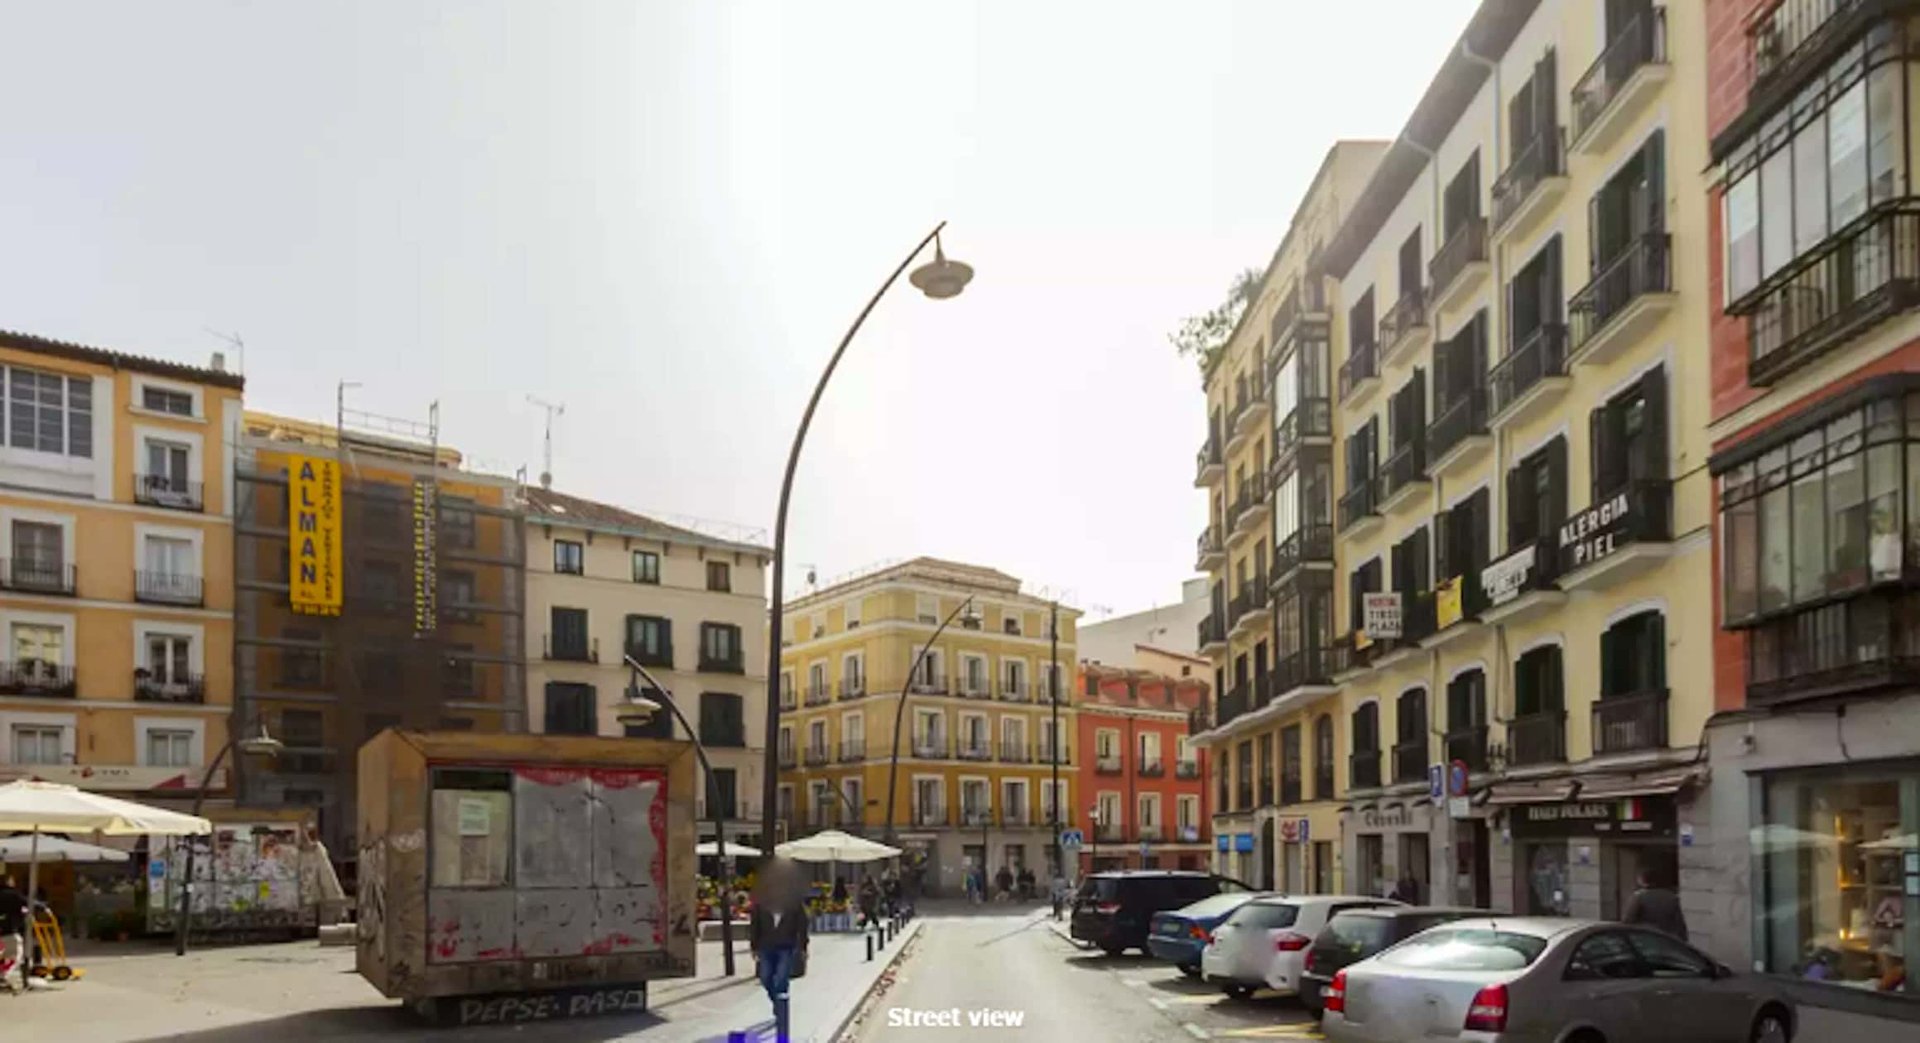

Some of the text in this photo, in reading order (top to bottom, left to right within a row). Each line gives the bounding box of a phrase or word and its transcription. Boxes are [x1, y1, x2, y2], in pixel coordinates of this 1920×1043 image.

[299, 461, 317, 585] ALMAN
[1560, 494, 1629, 549] ALERGIA
[1574, 533, 1616, 564] PIEL
